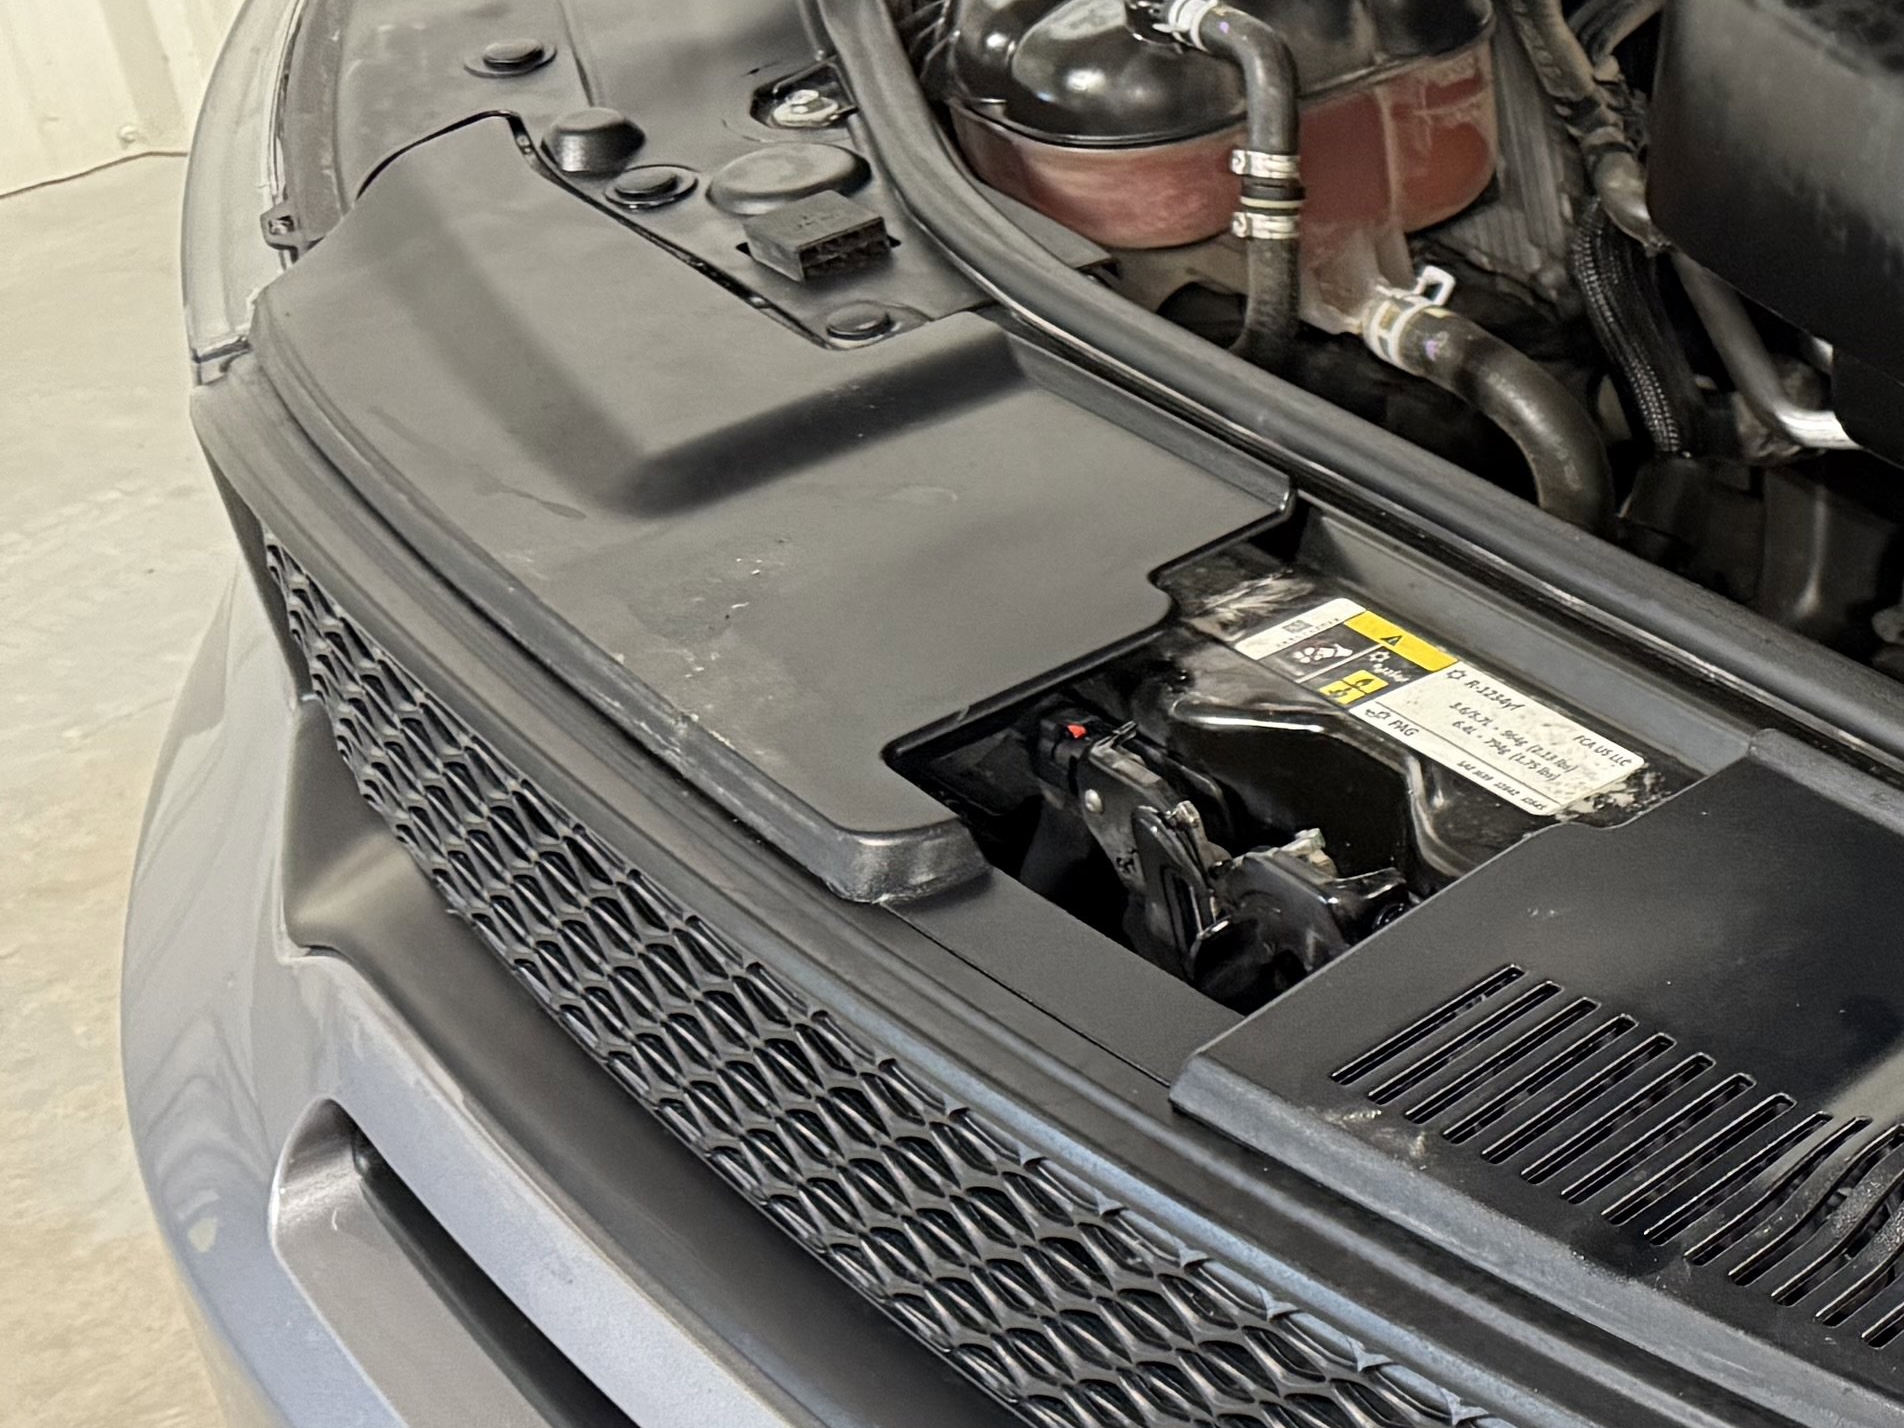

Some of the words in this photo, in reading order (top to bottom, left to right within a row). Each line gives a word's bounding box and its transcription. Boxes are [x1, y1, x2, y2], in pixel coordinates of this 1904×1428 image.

[1464, 679, 1525, 711] R-1234yf
[1387, 718, 1419, 737] PAG
[1572, 734, 1596, 749] FCA
[1593, 745, 1613, 757] US
[1608, 753, 1632, 767] LLC
